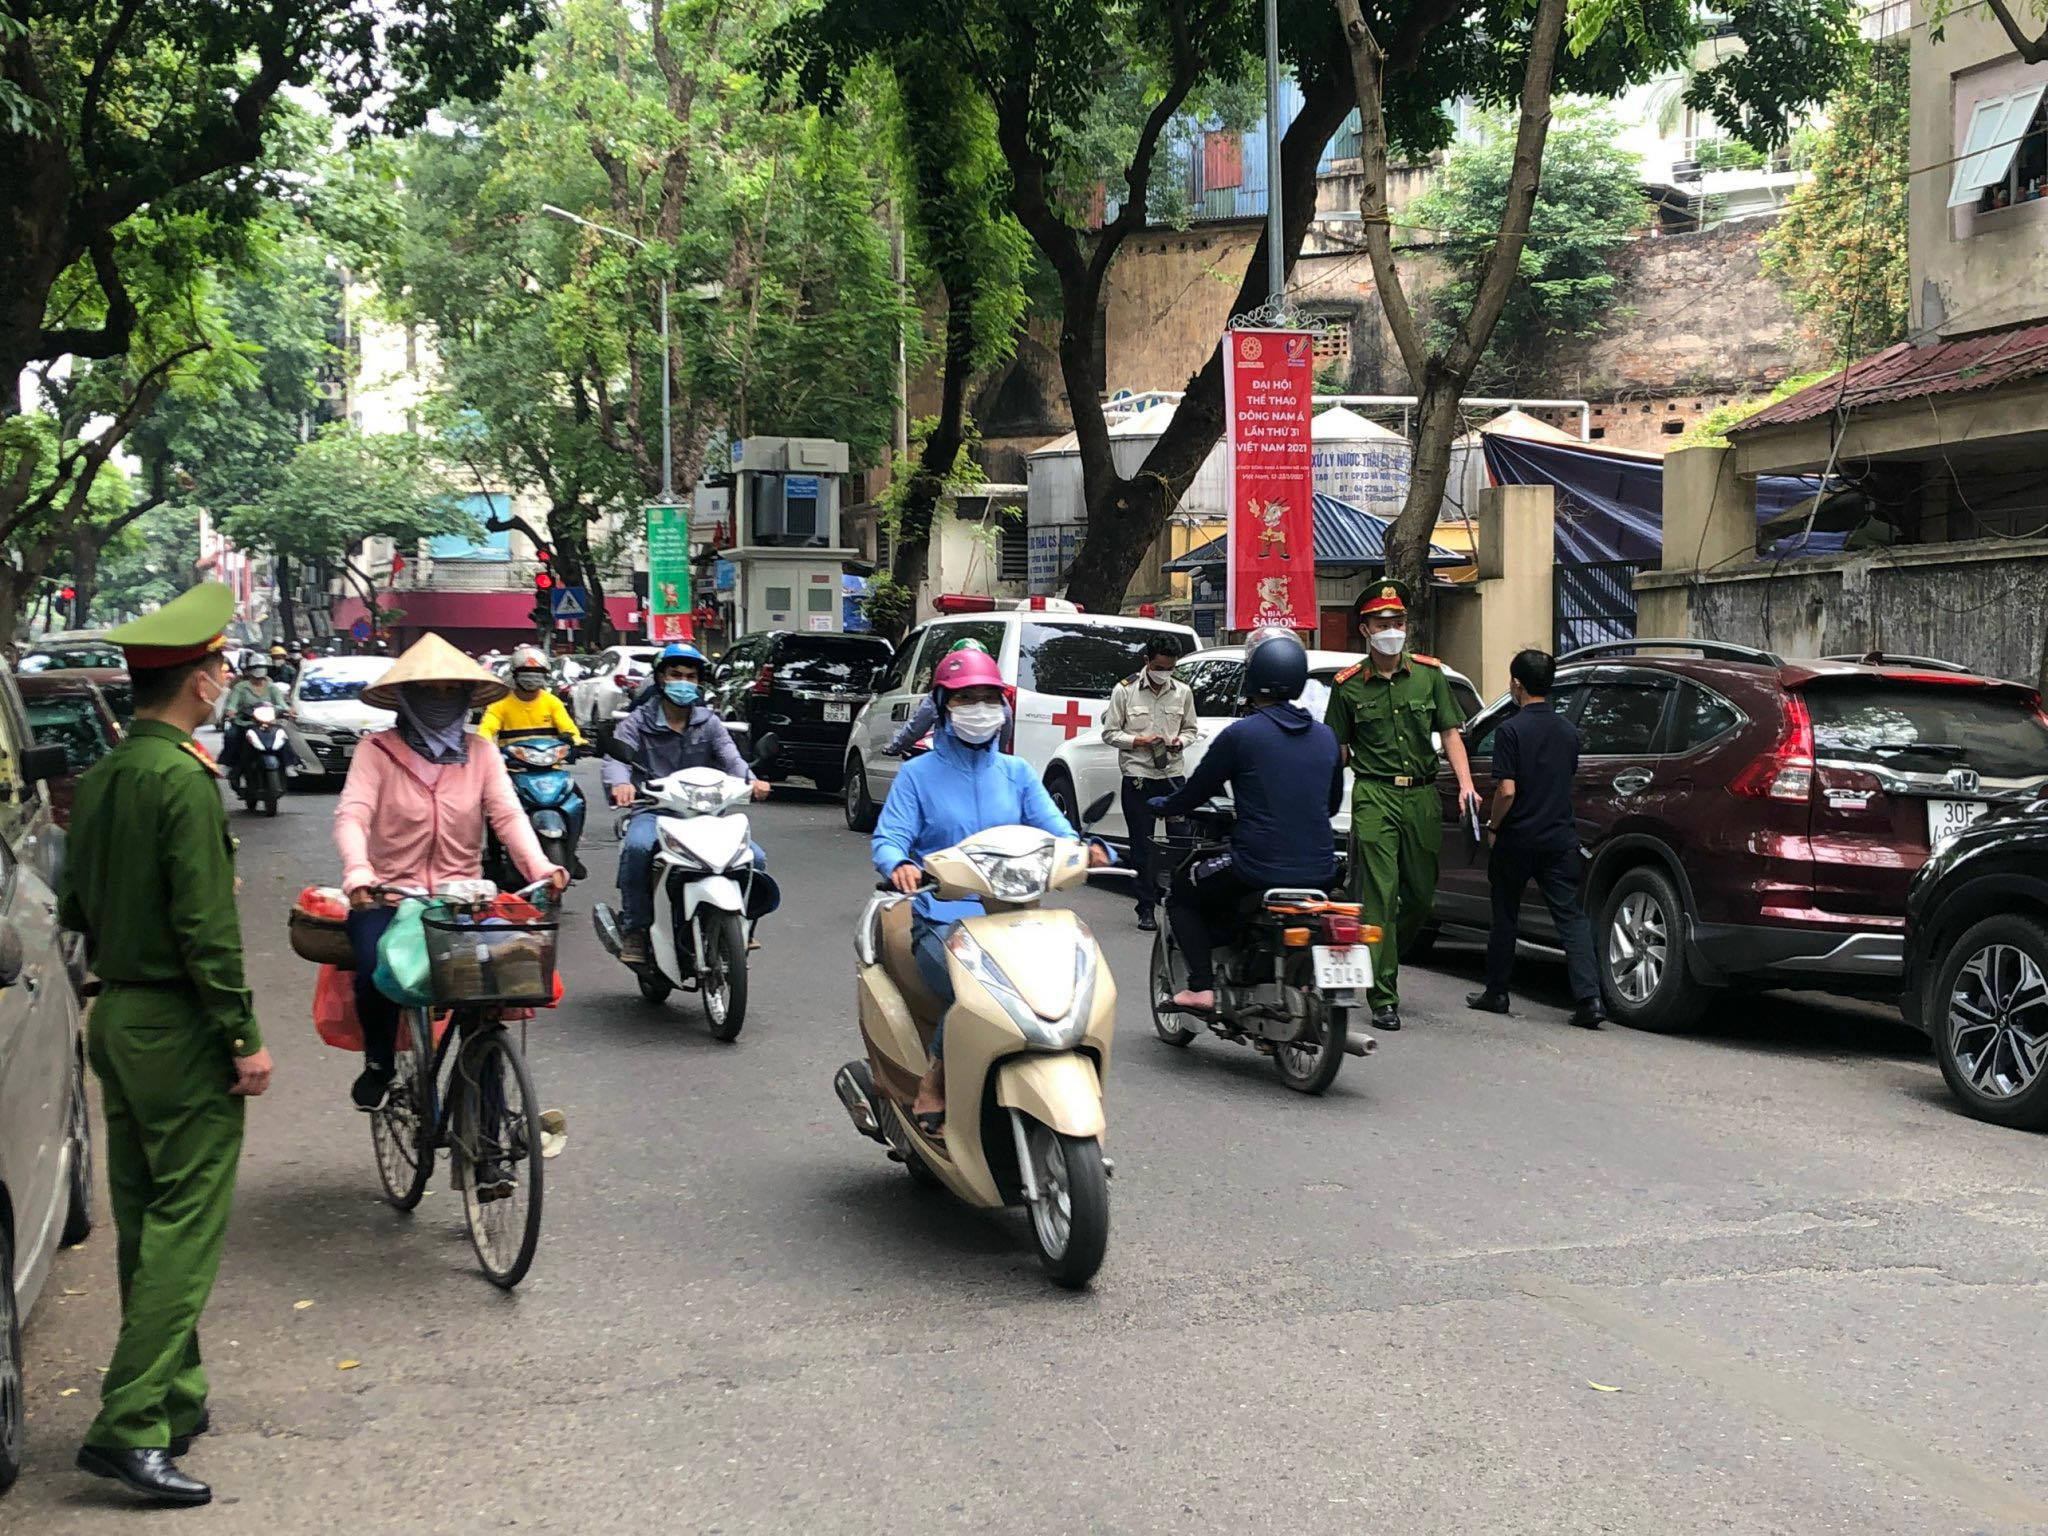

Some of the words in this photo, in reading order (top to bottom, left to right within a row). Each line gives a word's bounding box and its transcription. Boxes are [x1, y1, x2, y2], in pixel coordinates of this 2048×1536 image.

[1252, 380, 1270, 391] ĐẠI
[1273, 379, 1292, 391] HỘI
[1268, 396, 1297, 405] THAO
[1238, 410, 1269, 421] ĐÔNG
[1272, 412, 1295, 421] NAM
[1297, 411, 1305, 421] Á
[1291, 428, 1300, 436] 31
[1236, 441, 1259, 453] VIỆT
[1261, 443, 1285, 452] NAM
[1287, 443, 1307, 453] 2021
[1253, 617, 1297, 627] SAIGON
